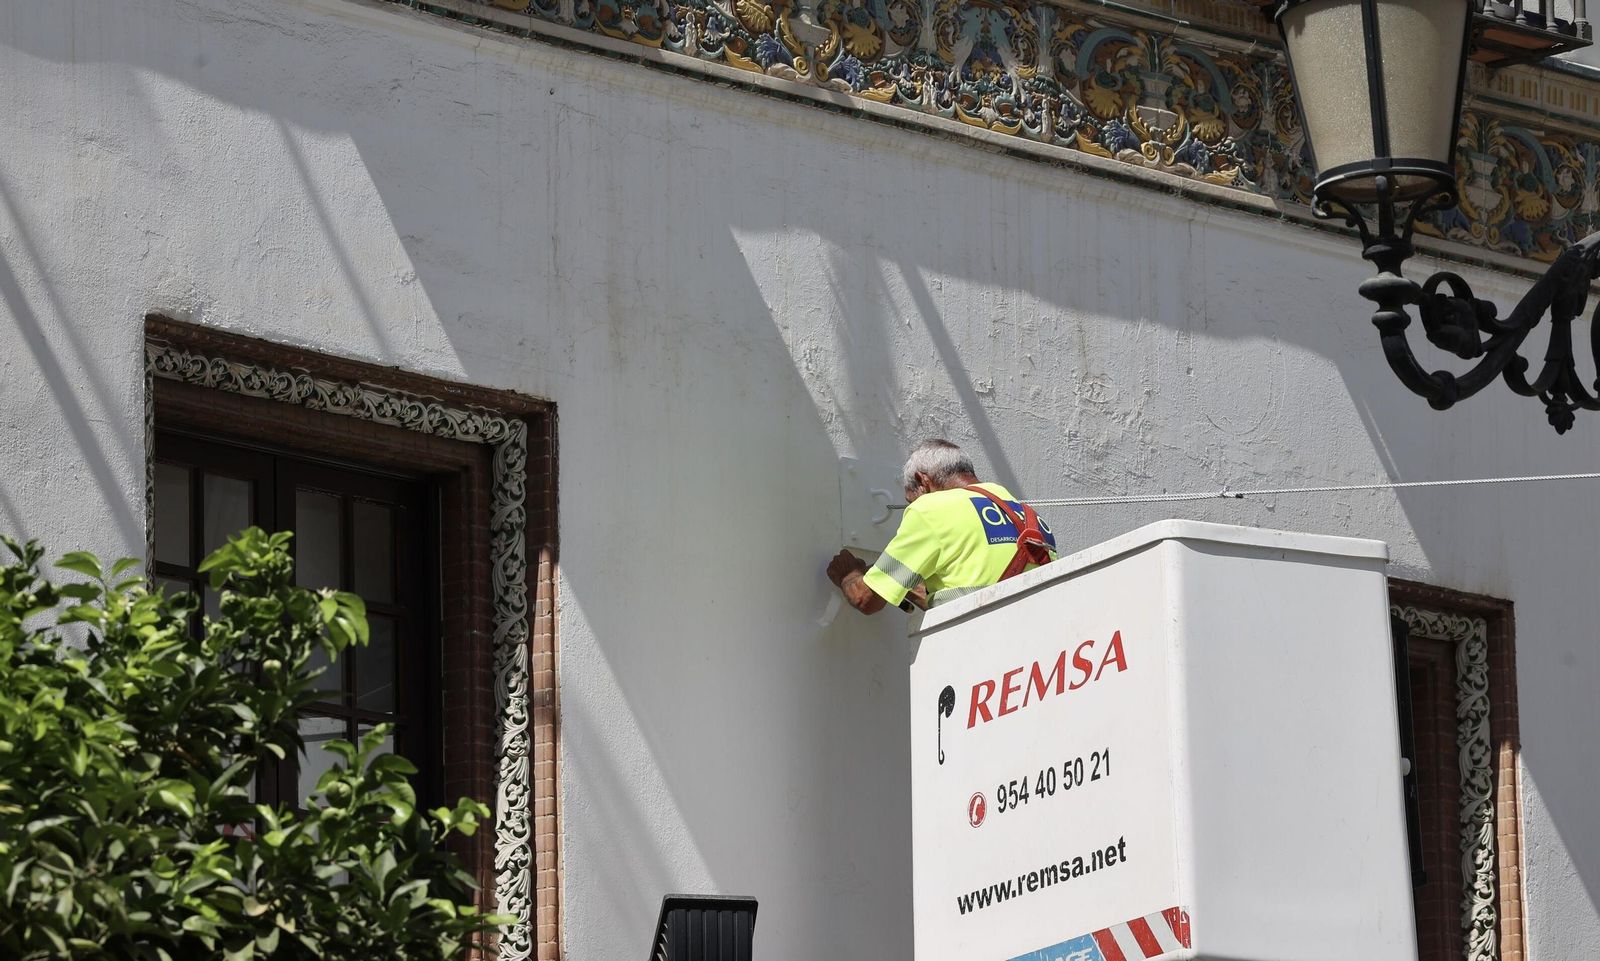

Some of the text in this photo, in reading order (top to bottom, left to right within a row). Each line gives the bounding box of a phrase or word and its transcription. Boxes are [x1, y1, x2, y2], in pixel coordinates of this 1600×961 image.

[968, 630, 1128, 729] REMSA
[997, 748, 1110, 814] 954 40 50 21
[957, 835, 1127, 915] www.remsa.net
